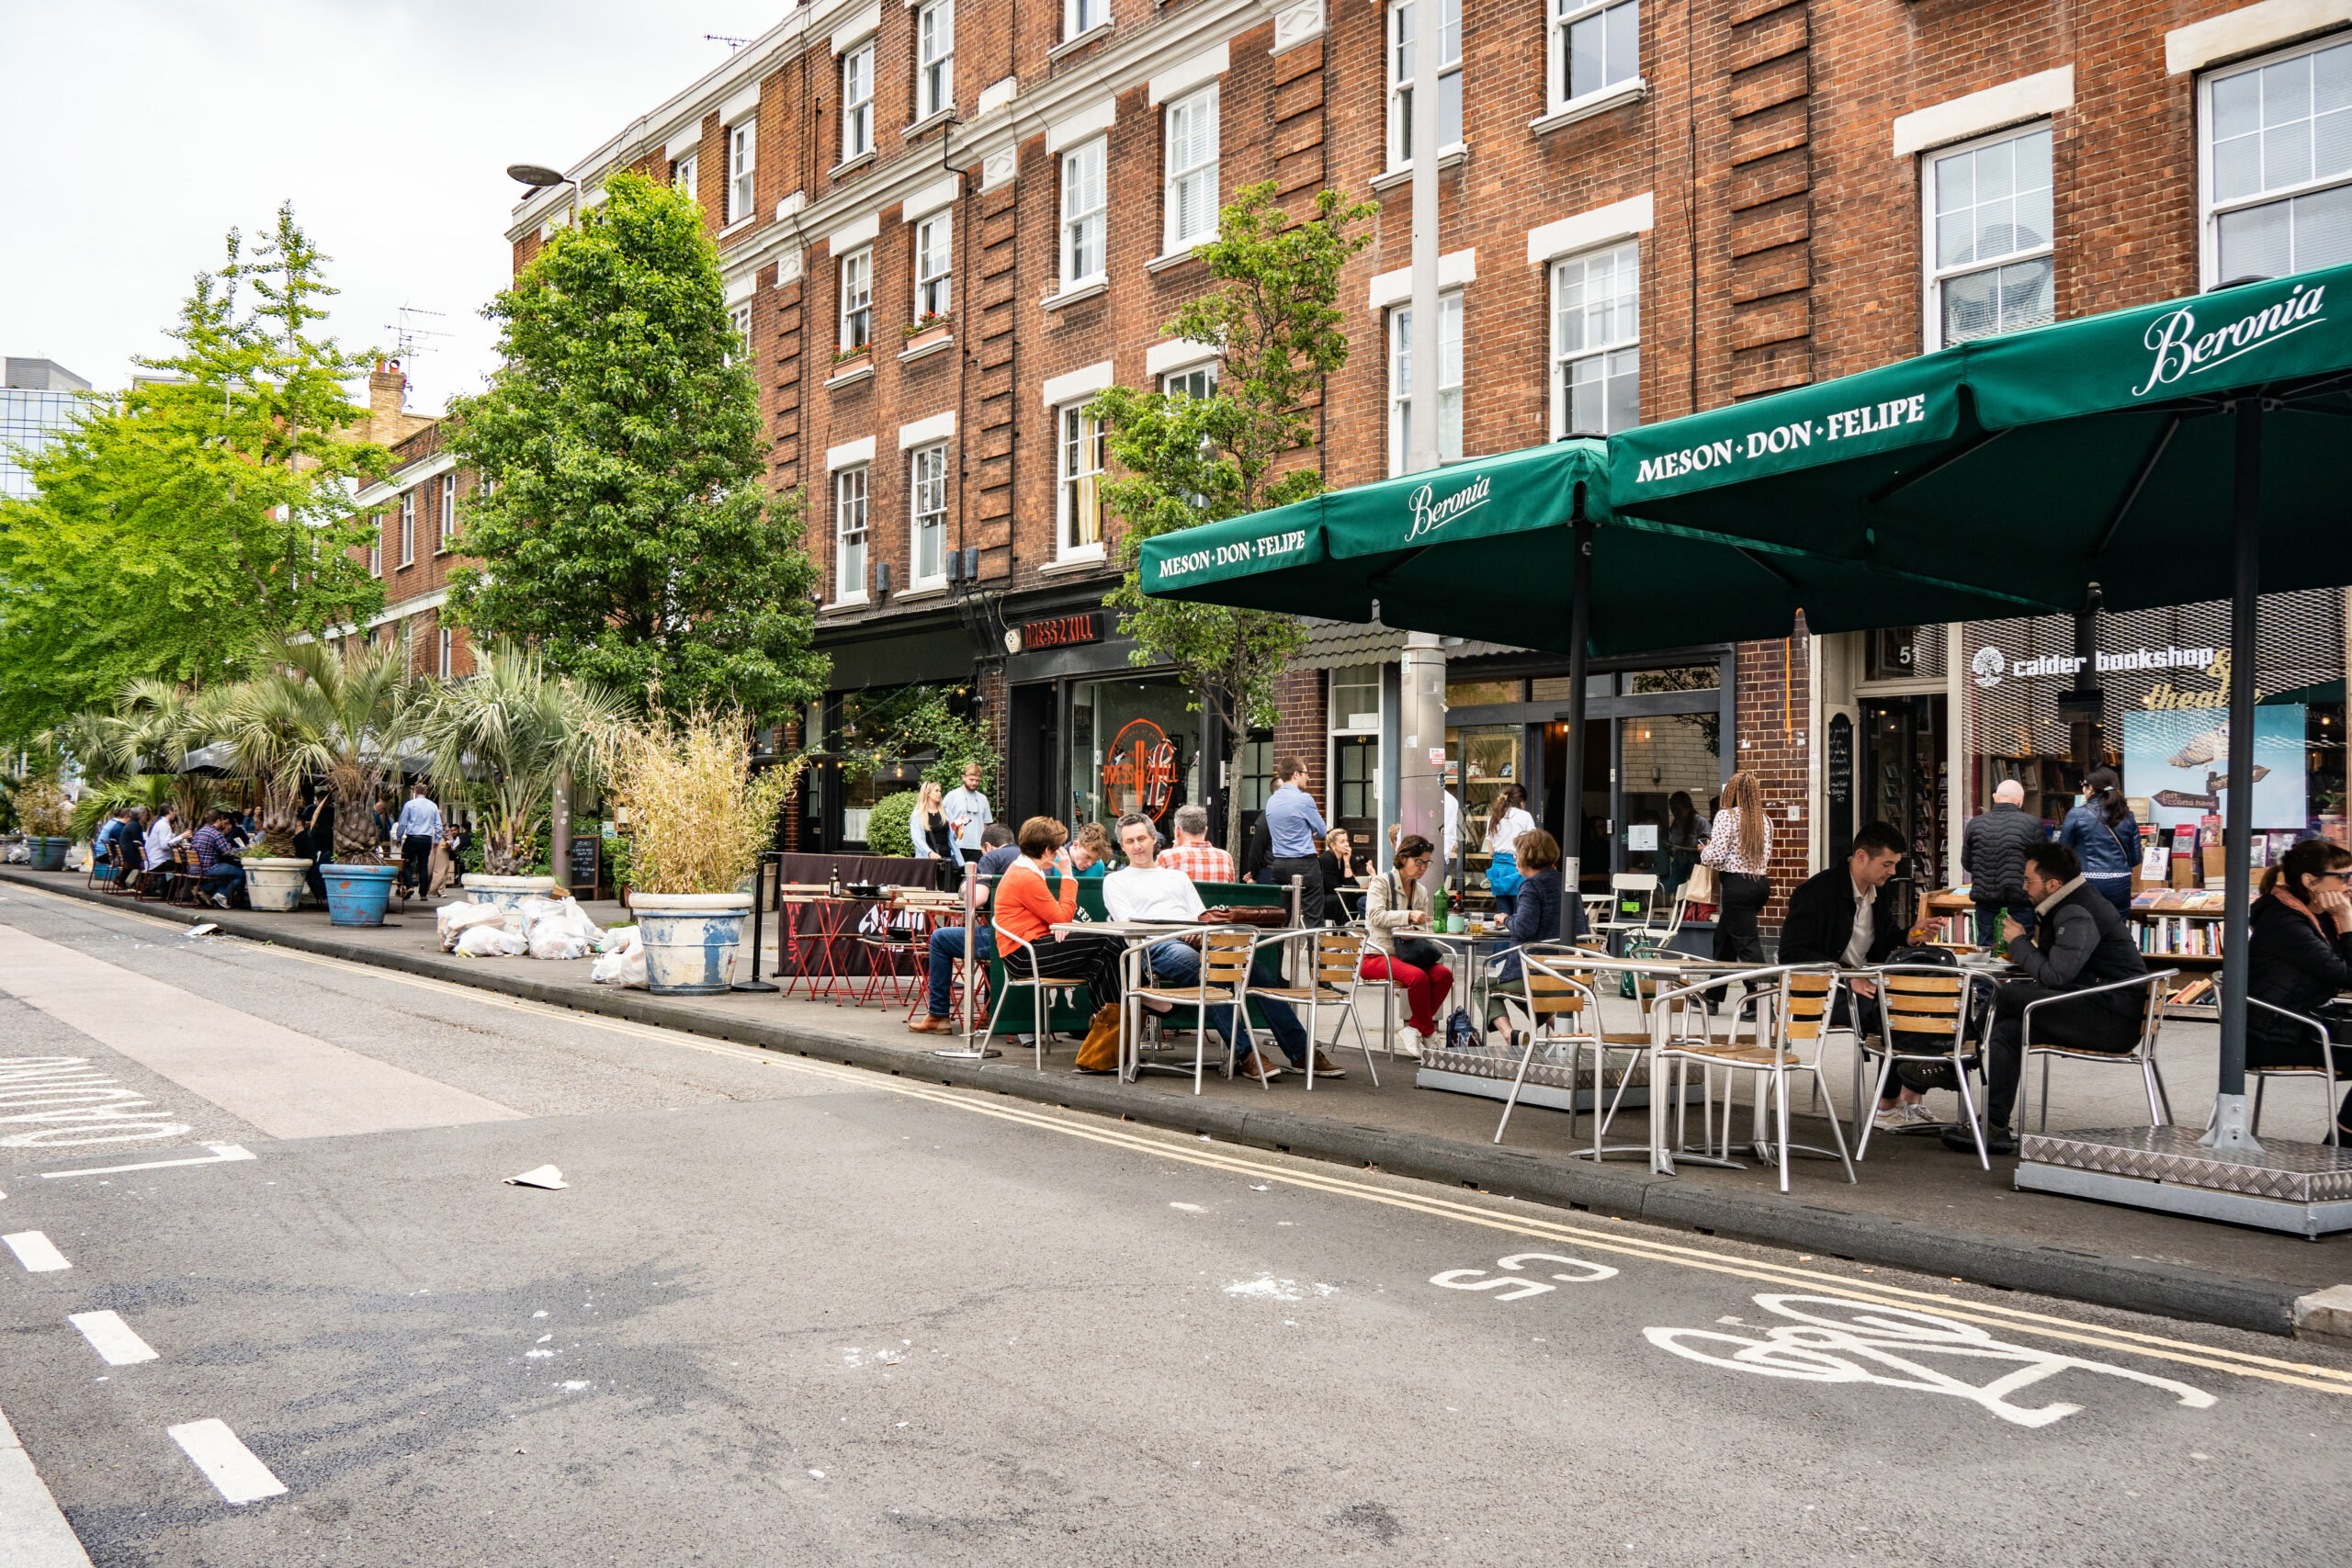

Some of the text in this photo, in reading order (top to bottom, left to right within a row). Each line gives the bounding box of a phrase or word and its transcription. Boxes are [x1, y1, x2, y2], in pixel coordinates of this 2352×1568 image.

[2132, 285, 2325, 398] Beronia
[1635, 393, 1925, 483] MESON DON FELIPE
[1404, 474, 1491, 542] Beronia
[1159, 529, 1306, 579] MESON DON FELIPE
[1024, 620, 1057, 649] DRESS
[1067, 615, 1093, 642] KILL
[2013, 654, 2087, 677] calder
[2096, 645, 2215, 671] bookshop
[1103, 764, 1135, 785] DRESS
[1147, 763, 1152, 784] 2
